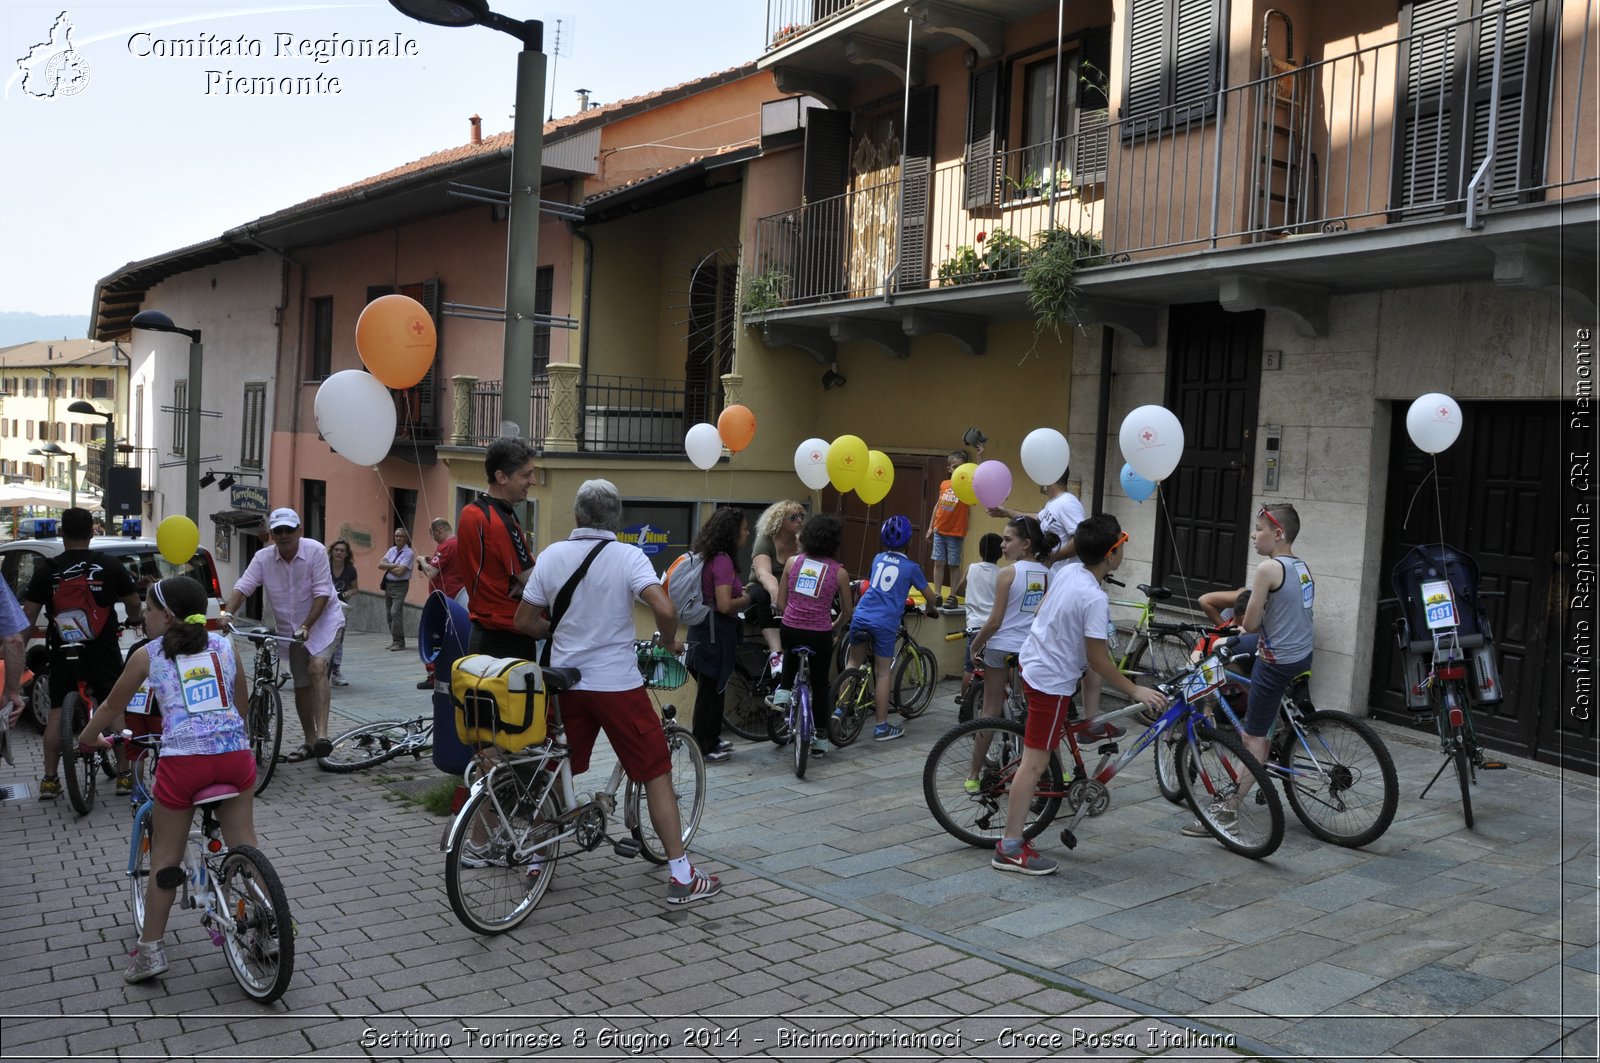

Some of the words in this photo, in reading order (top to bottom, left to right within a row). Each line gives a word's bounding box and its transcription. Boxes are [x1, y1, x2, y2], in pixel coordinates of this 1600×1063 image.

[798, 578, 816, 589] 398
[871, 562, 899, 592] 10
[1432, 606, 1450, 620] 491
[192, 682, 213, 702] 477
